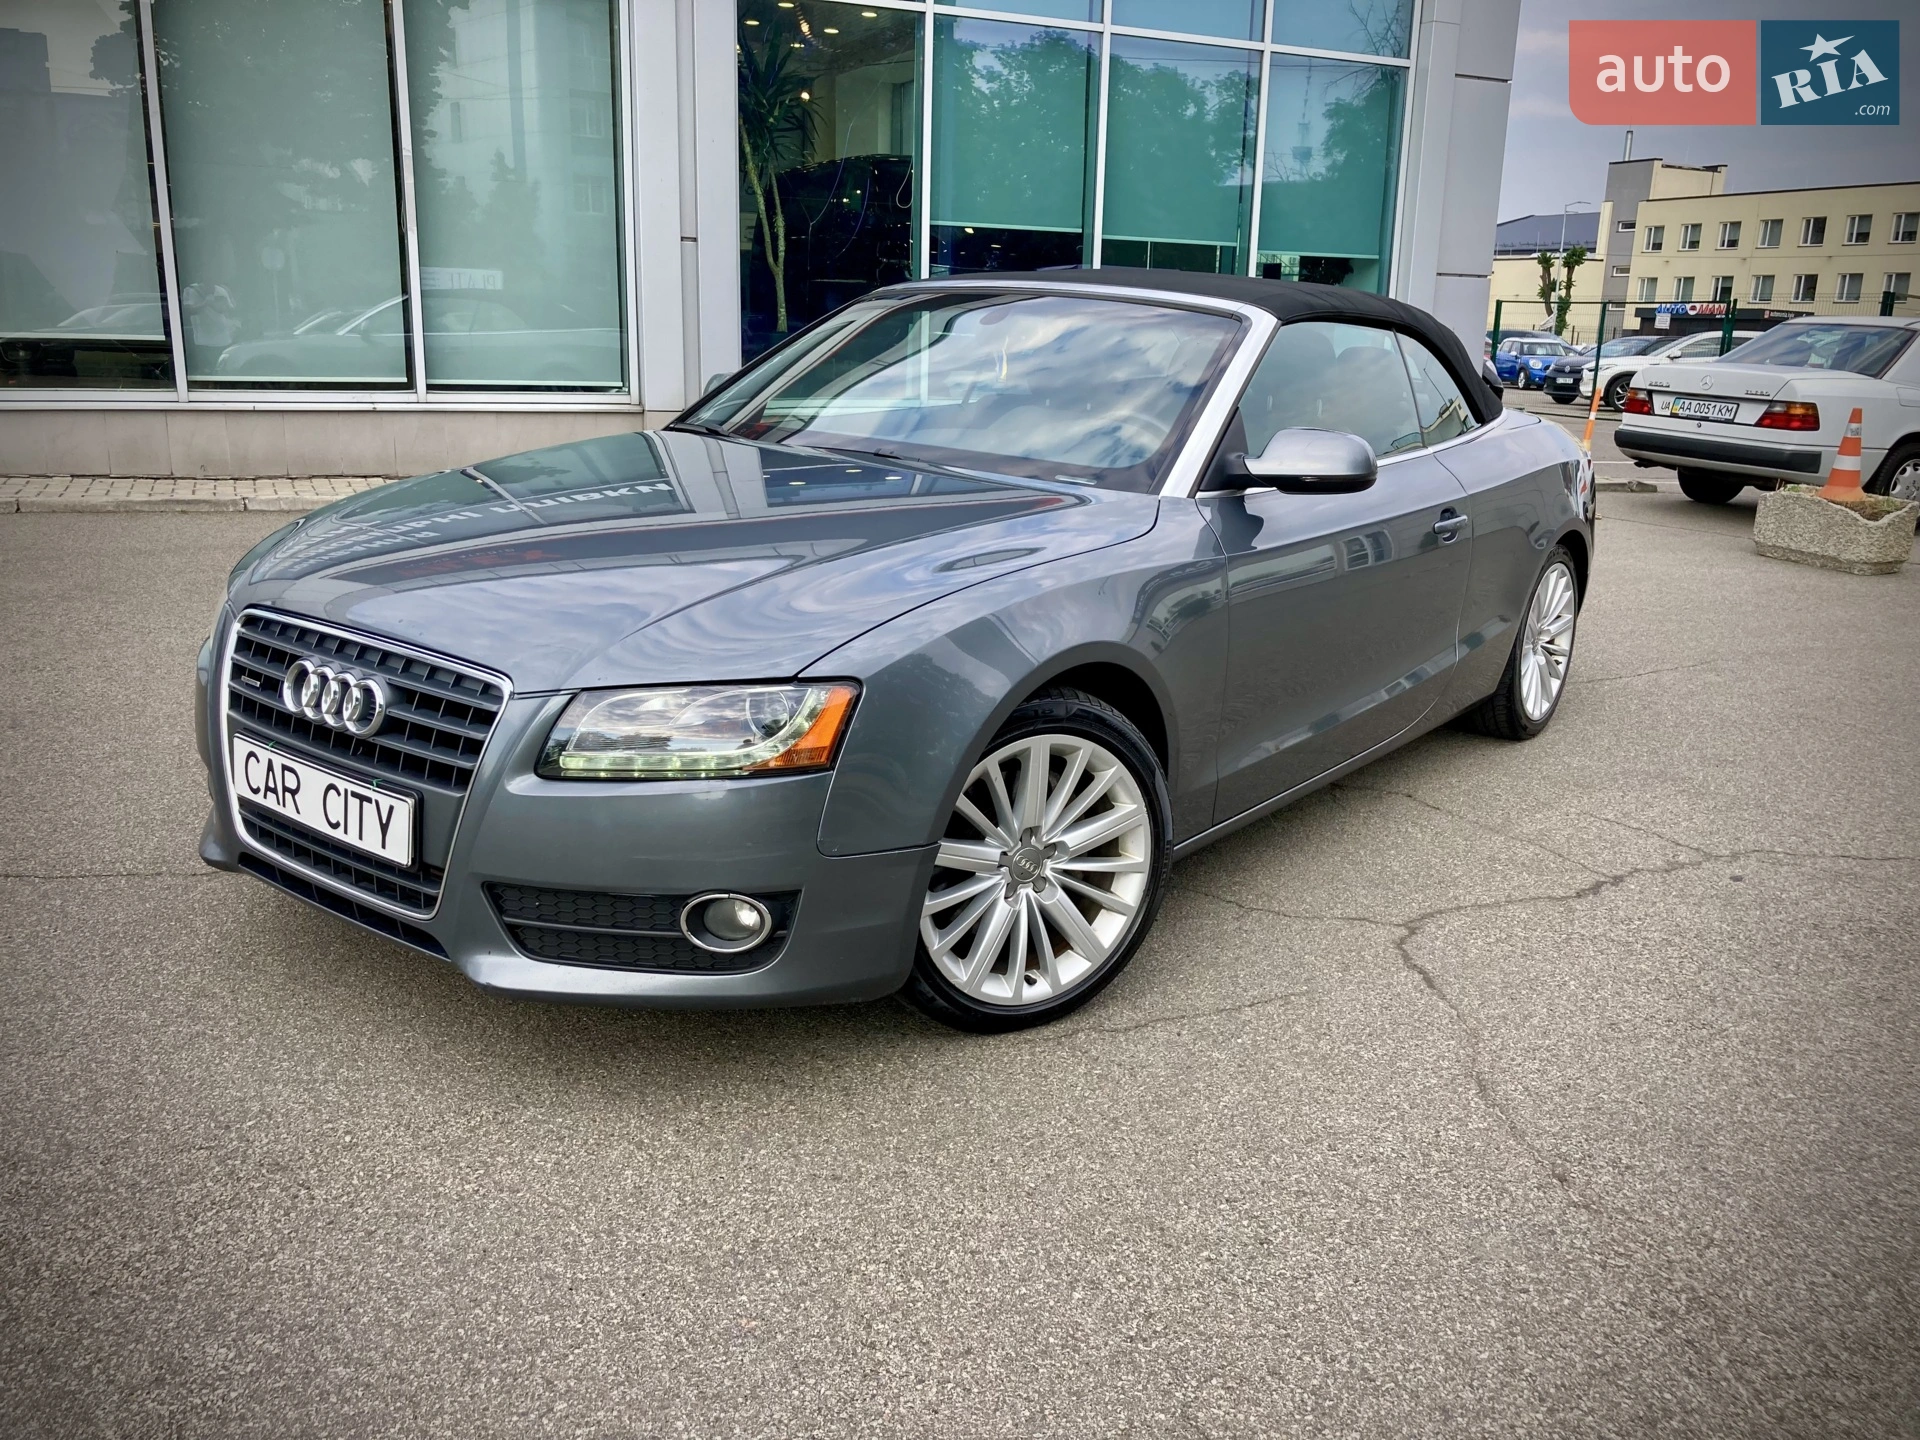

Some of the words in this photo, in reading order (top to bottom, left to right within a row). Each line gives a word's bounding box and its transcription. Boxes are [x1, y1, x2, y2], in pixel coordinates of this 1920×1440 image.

[1655, 303, 1687, 314] AUTO
[1661, 400, 1671, 411] UA
[1678, 400, 1692, 413] AA
[1693, 402, 1716, 416] 0051
[1718, 405, 1735, 418] KM
[244, 750, 302, 815] CAR
[322, 783, 395, 850] CITY
